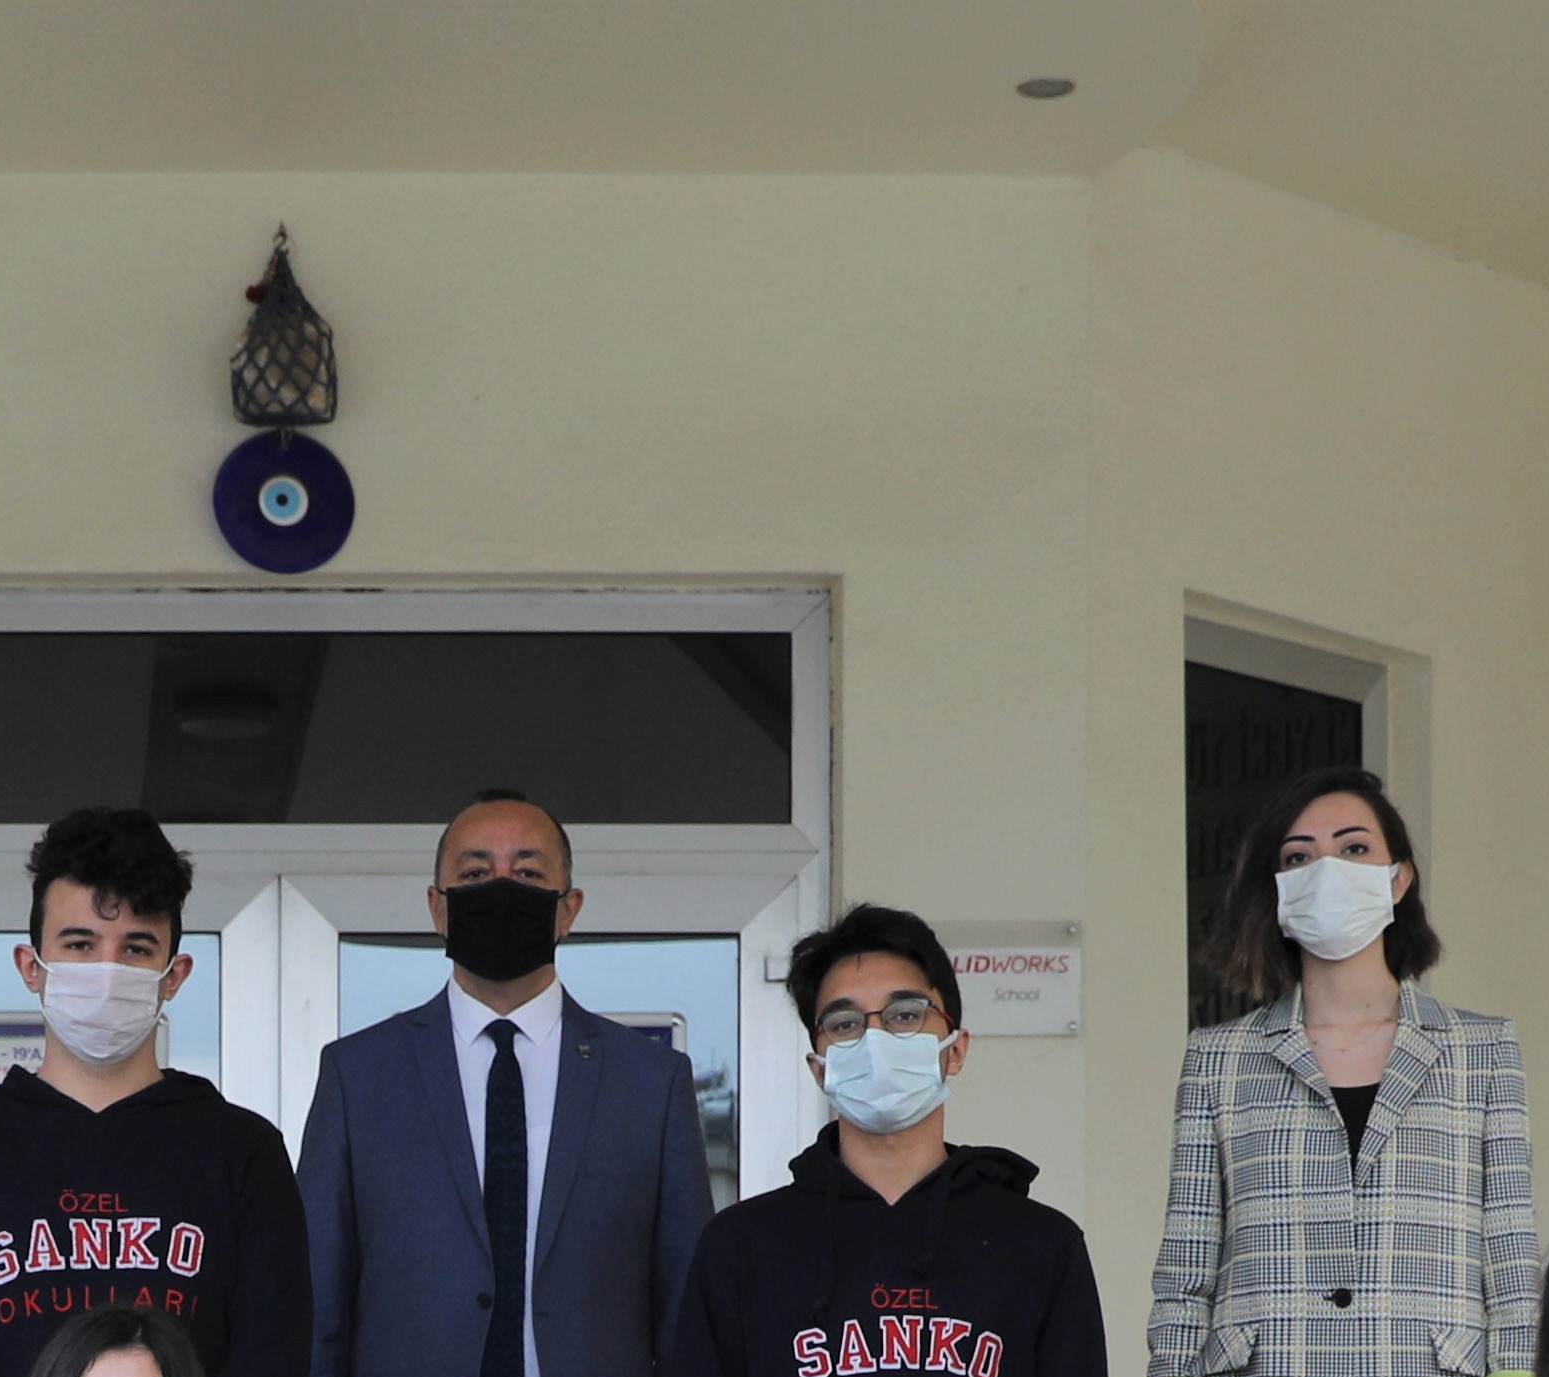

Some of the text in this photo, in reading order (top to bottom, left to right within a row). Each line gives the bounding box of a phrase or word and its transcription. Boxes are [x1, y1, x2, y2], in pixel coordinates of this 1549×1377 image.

[952, 955, 1070, 974] LIDWORKS
[993, 987, 1040, 1003] School
[59, 1189, 129, 1213] ÖZEL
[871, 1283, 939, 1310] ÖZEL
